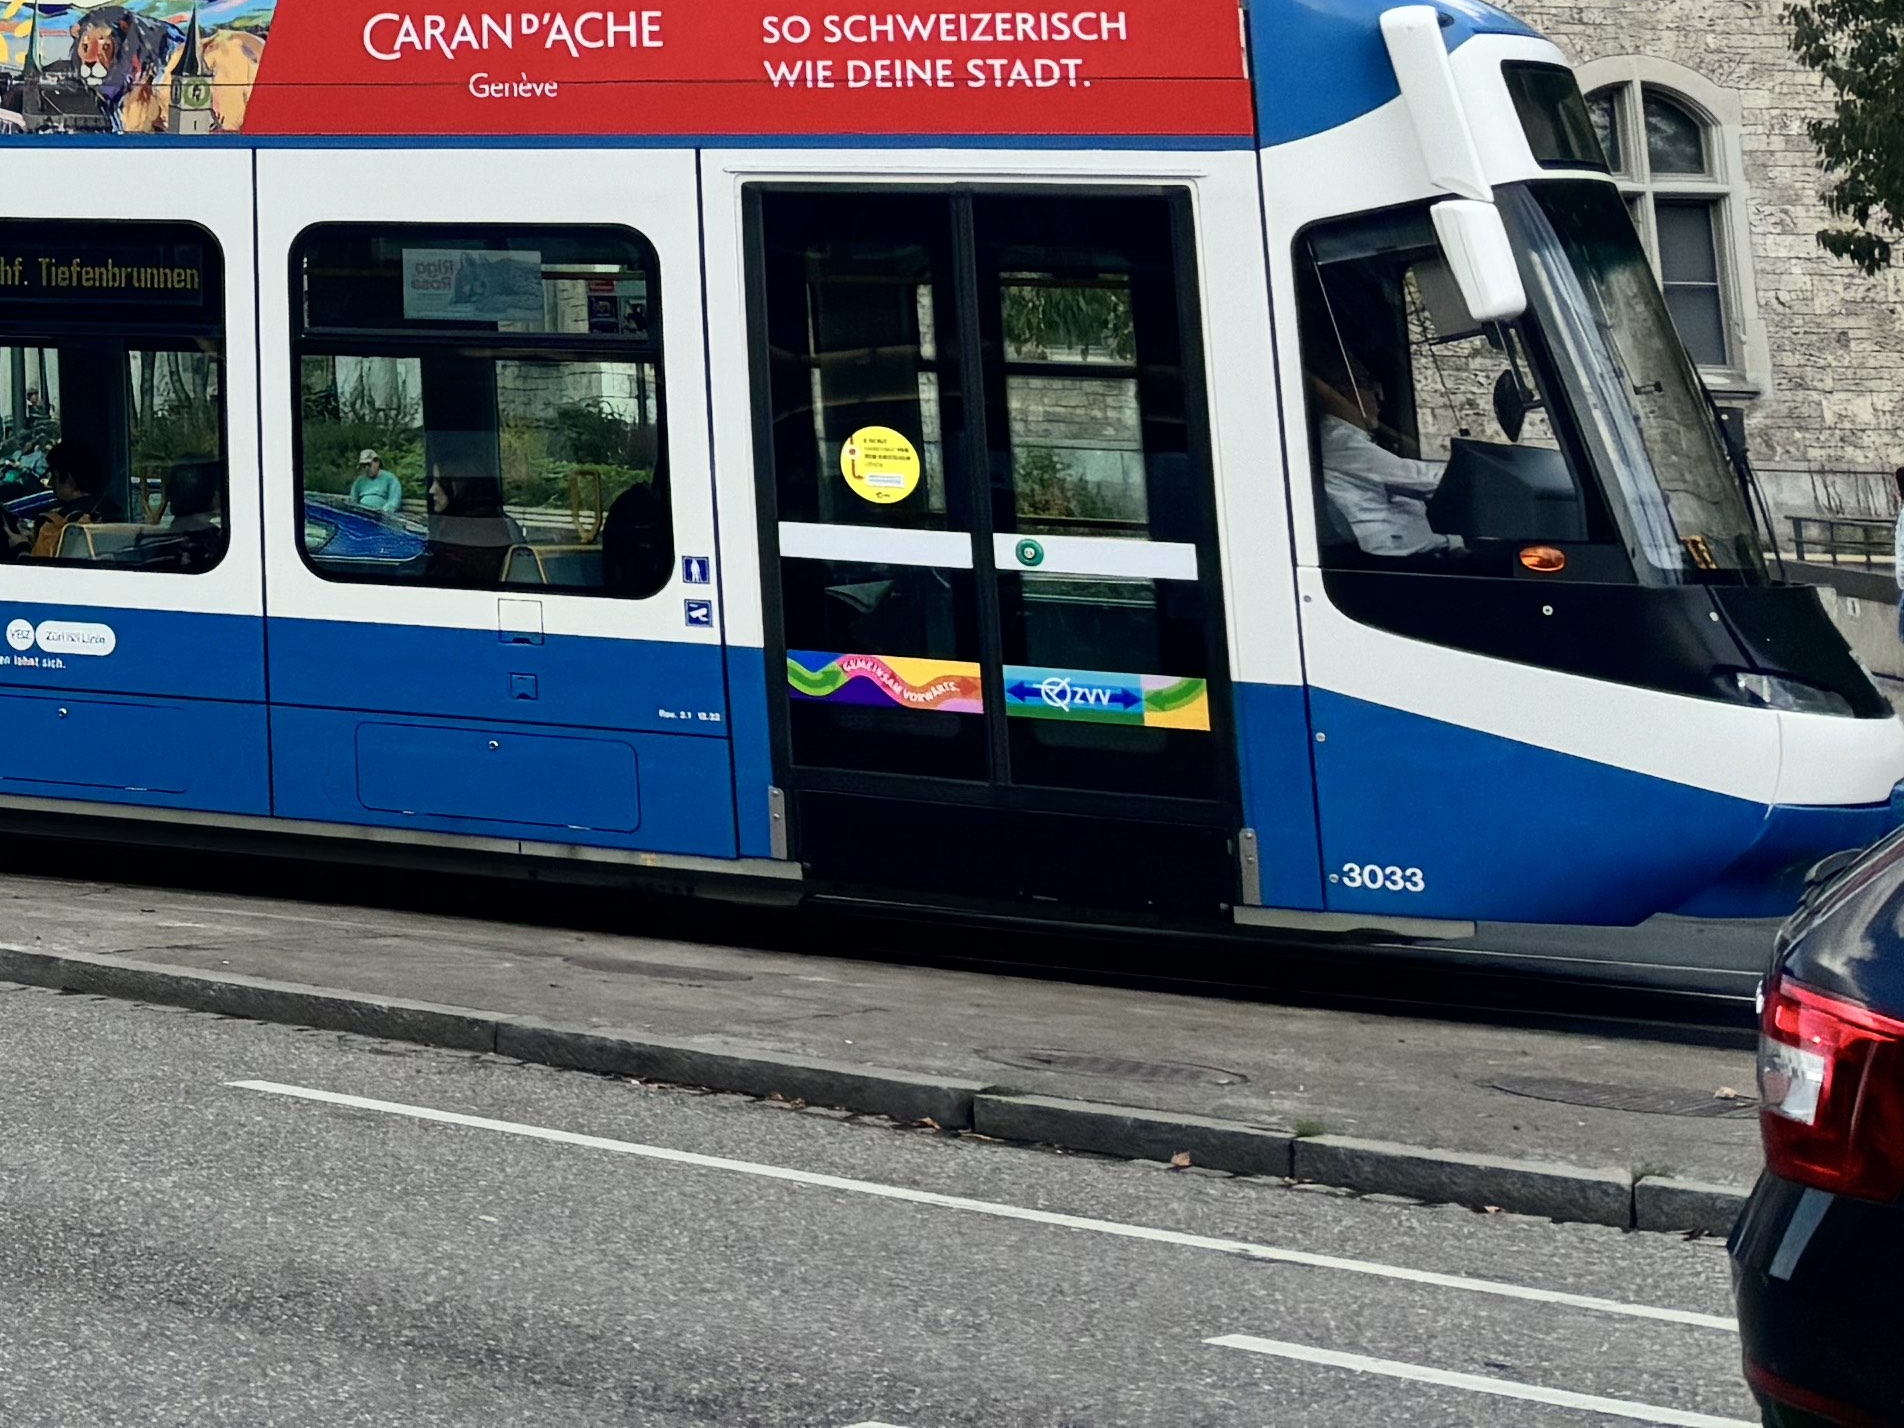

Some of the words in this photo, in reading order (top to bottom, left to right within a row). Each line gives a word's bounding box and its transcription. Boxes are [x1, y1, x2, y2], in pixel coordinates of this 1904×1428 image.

[363, 12, 513, 61] CARAN
[762, 16, 810, 44] SO
[823, 11, 1127, 44] SCHWEIZERISCH
[469, 72, 558, 98] Genève
[763, 60, 835, 89] WIE
[847, 59, 955, 89] DEINE
[967, 58, 1091, 88] STADT.
[38, 257, 199, 289] Tiefenbrunnen
[842, 659, 903, 695] GEMEINSAM
[1073, 689, 1112, 707] ZVV
[1342, 862, 1425, 892] 3033
